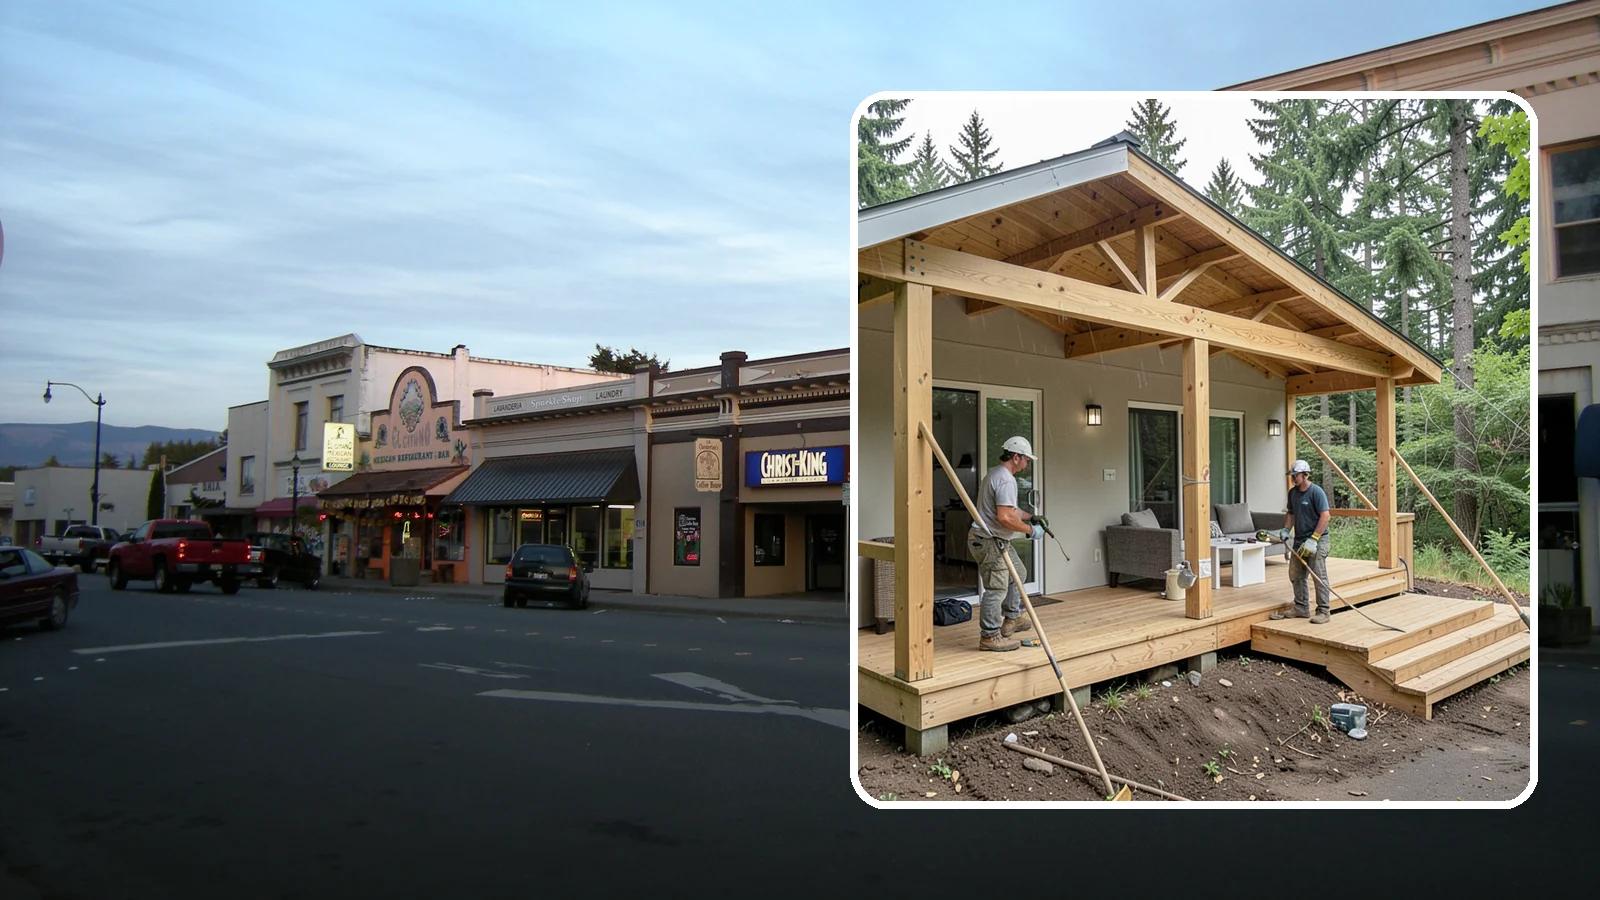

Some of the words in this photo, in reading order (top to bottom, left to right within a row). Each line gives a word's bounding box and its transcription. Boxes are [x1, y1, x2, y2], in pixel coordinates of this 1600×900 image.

[493, 402, 523, 413] LAVANDERIA
[530, 397, 561, 409] Sparkle
[562, 394, 582, 404] Shop
[595, 388, 624, 400] LAUNDRY
[373, 455, 396, 464] MEXICAN
[397, 451, 433, 462] RESTAURANT
[438, 450, 450, 459] BAR
[760, 451, 797, 478] CHRIST
[799, 449, 828, 477] KING
